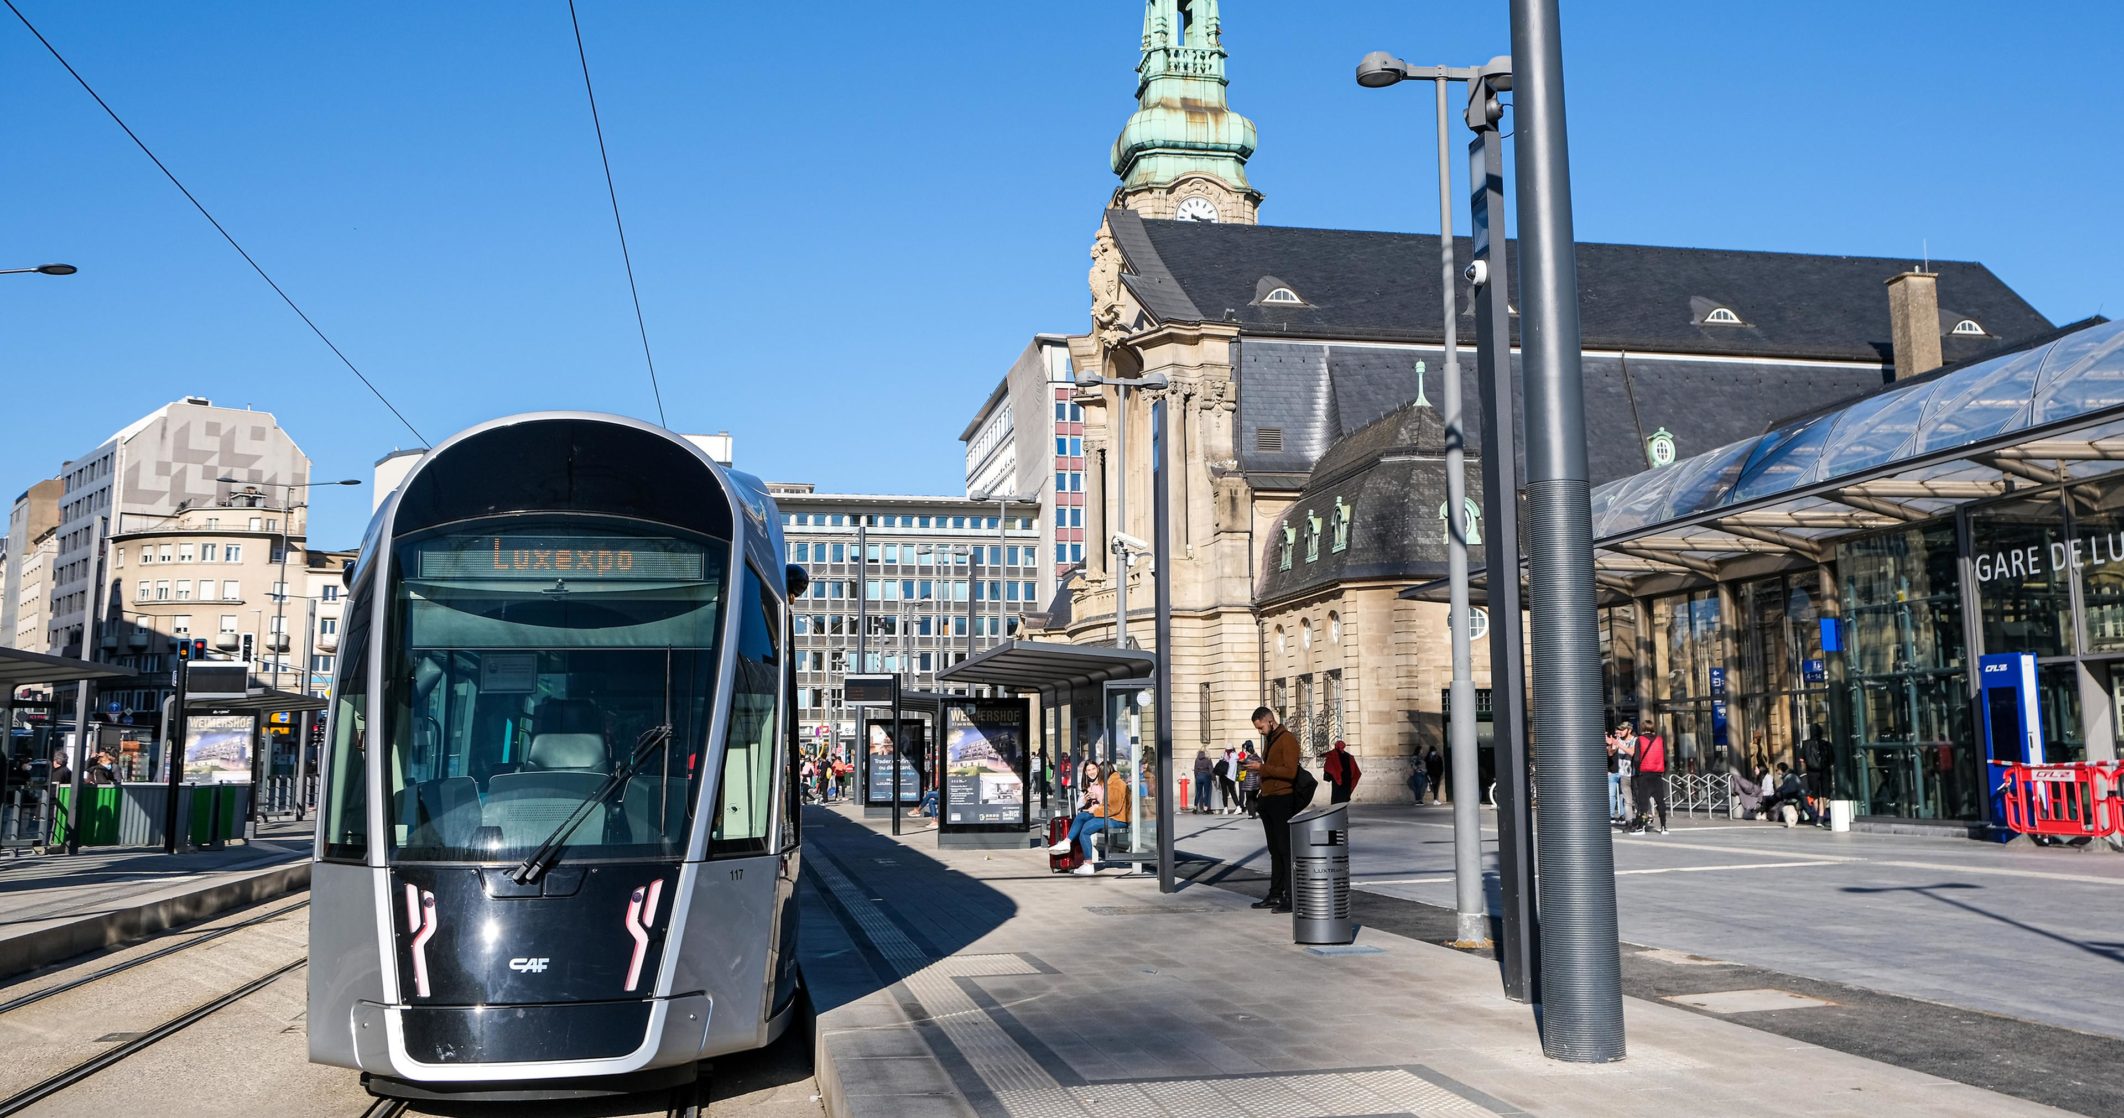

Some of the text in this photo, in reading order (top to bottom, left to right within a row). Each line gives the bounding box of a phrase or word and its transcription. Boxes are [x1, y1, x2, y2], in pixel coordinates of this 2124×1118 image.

[493, 538, 633, 577] Luxexpo
[1975, 546, 2041, 582] GARE
[2050, 538, 2085, 572] DE
[190, 718, 252, 728] WEIMERSHOF
[729, 868, 744, 881] 117
[508, 957, 550, 973] CAF
